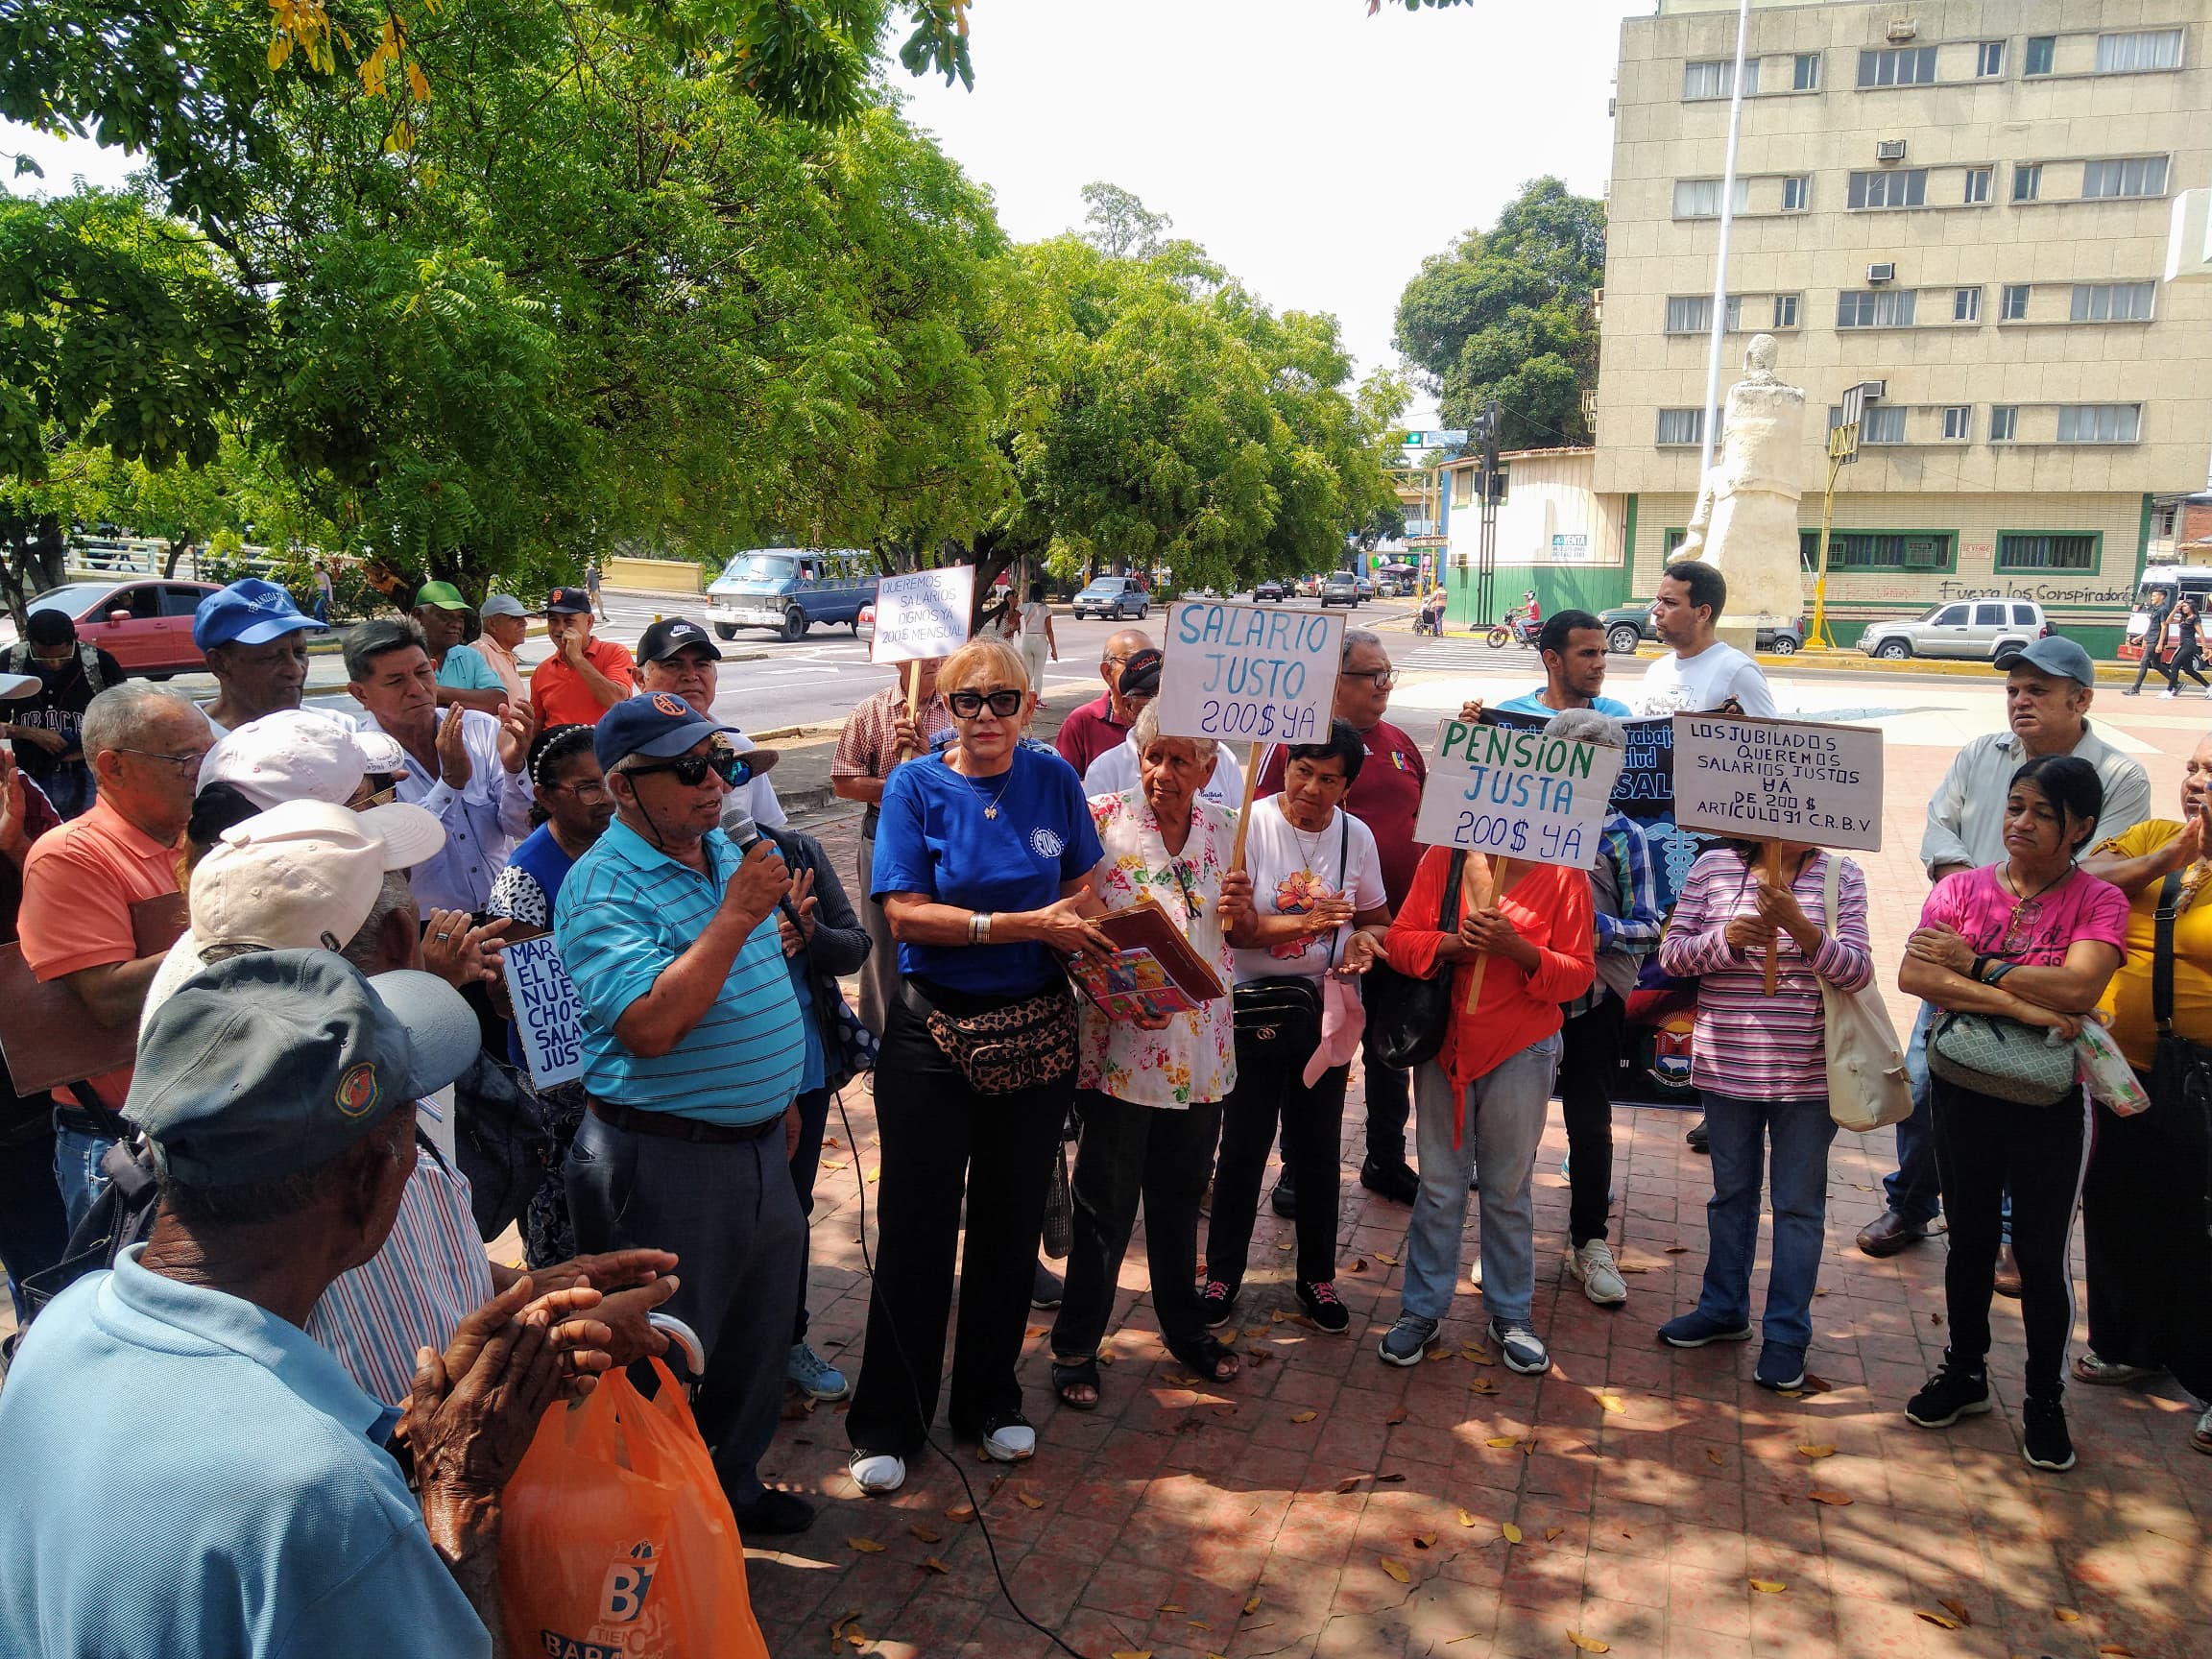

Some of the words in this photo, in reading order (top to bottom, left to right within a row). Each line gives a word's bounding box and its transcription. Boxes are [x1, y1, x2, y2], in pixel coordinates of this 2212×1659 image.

[882, 575, 942, 594] QUEREMOS
[1939, 580, 2001, 600] Fuera
[2006, 581, 2033, 600] los
[900, 588, 957, 609] SALARIOS
[673, 624, 691, 633] NIKE
[898, 611, 940, 626] DIGNOS
[912, 625, 964, 641] MENSUAL
[1202, 653, 1307, 701] JUSTO
[1201, 700, 1277, 737] 200$
[1282, 701, 1317, 738] YÁ
[1691, 723, 1725, 739] LOS
[1729, 726, 1837, 752] JUBILADOS
[1738, 745, 1841, 767] QUEREMOS
[1697, 755, 1785, 777] SALARIOS
[1791, 765, 1861, 784] JUSTOS
[1463, 764, 1574, 815] JUSTA
[1734, 790, 1757, 805] DE
[1766, 794, 1798, 809] 200
[1696, 801, 1779, 823] ARTÍCULO
[1783, 810, 1802, 824] 91
[1454, 810, 1529, 853] 200$
[1539, 822, 1583, 860] YÁ
[517, 963, 545, 987] EL
[520, 977, 574, 1008] NUE
